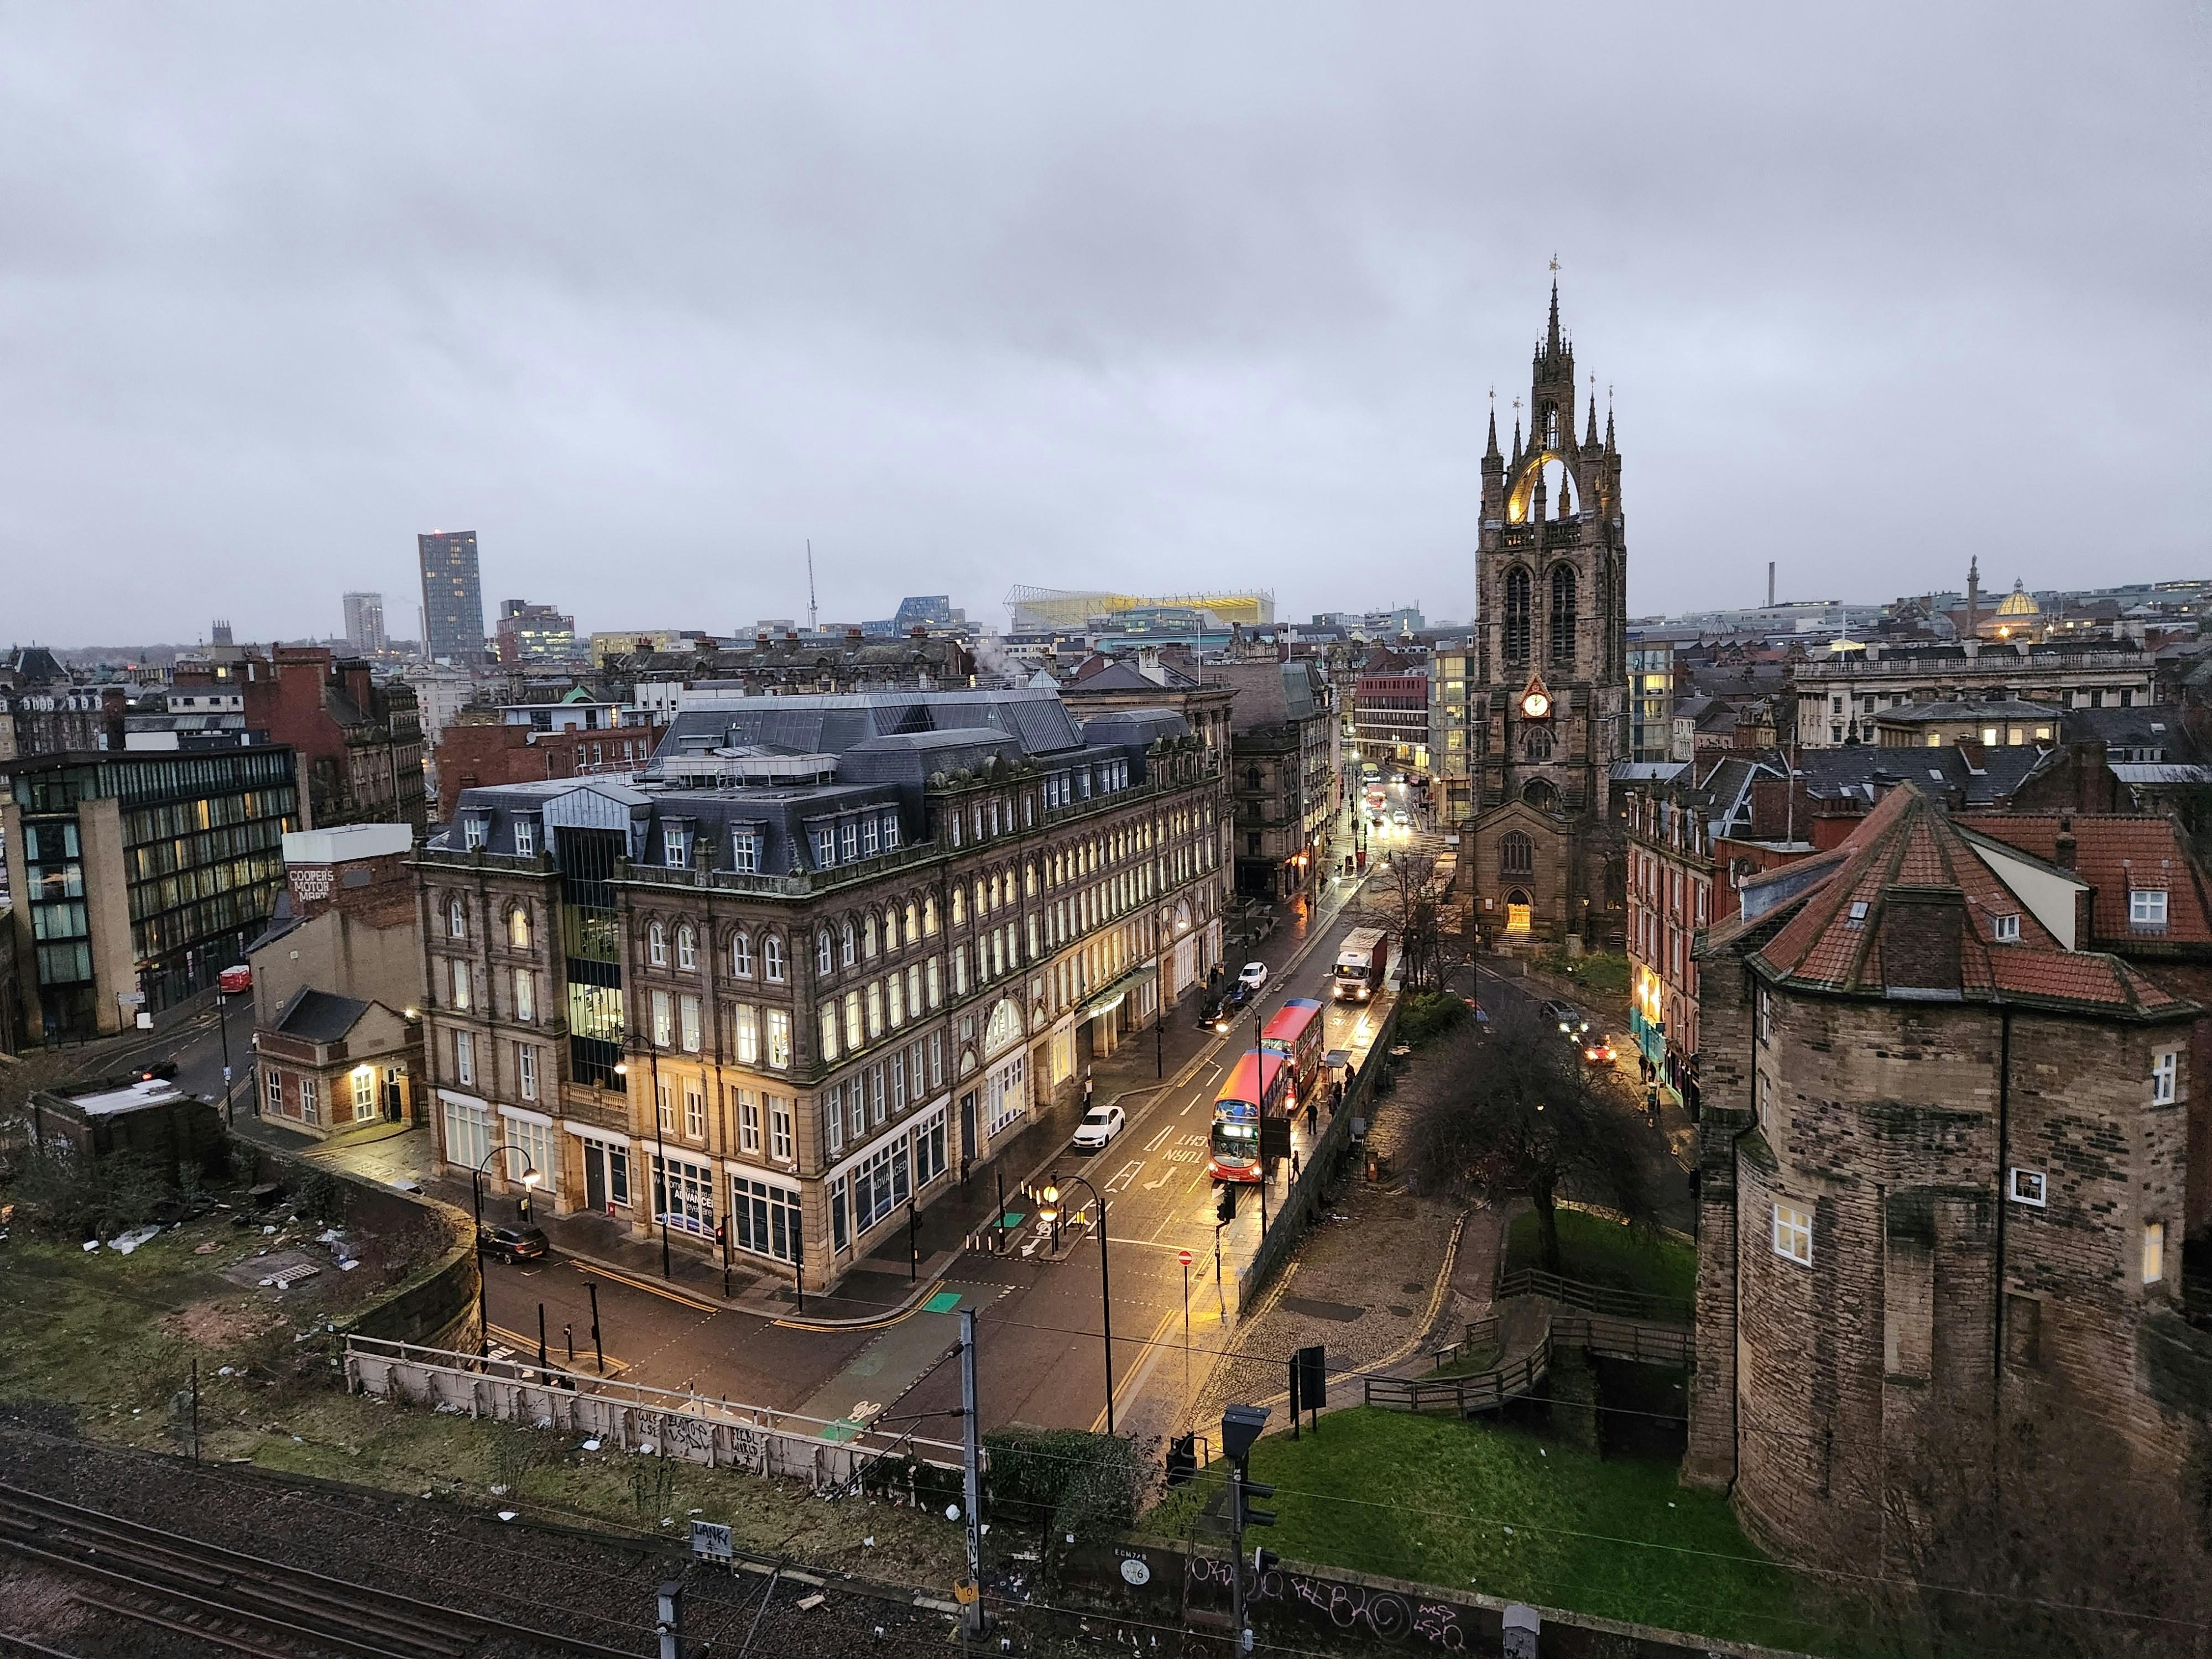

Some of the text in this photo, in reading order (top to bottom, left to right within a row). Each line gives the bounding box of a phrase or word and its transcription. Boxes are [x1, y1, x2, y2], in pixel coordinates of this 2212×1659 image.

[290, 868, 333, 881] COOPER'S
[294, 881, 329, 892] MOTOR
[1161, 1149, 1204, 1164] TURN
[1137, 1569, 1144, 1579] 6
